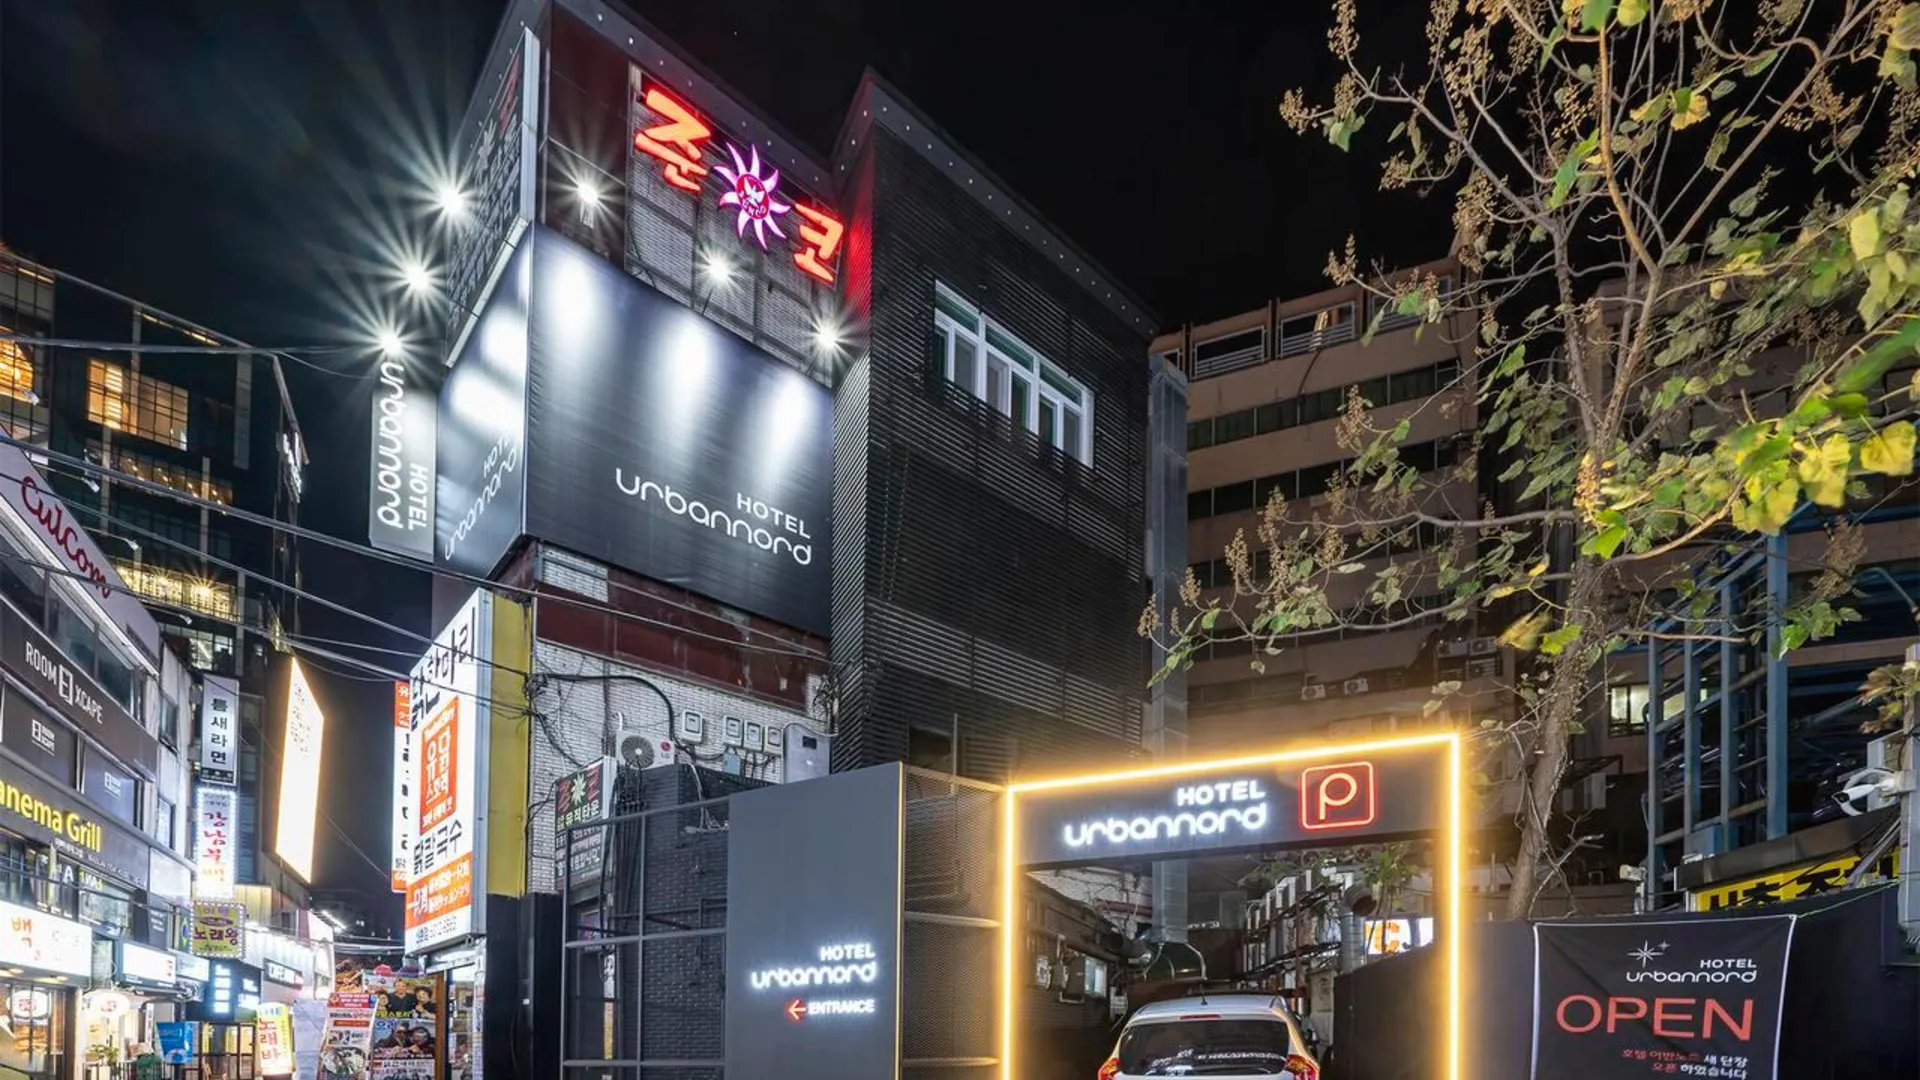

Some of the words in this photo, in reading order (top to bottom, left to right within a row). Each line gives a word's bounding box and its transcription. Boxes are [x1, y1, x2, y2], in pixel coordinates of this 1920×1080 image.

[635, 88, 711, 193] 준
[794, 202, 844, 282] 코
[377, 361, 407, 529] urbannord
[408, 462, 429, 530] HOTEL
[445, 446, 517, 560] urbannord
[616, 468, 812, 564] urbannord
[737, 492, 811, 539] HOTEL
[26, 641, 57, 685] ROOM
[1176, 780, 1266, 807] HOTEL
[66, 812, 101, 853] Grill
[1063, 803, 1267, 847] urbannord
[819, 943, 877, 961] HOTEL
[1700, 958, 1757, 968] HOTEL
[750, 961, 878, 989] urbannord
[1626, 970, 1757, 983] urbannord
[807, 999, 876, 1015] ENTRANCE
[1556, 995, 1753, 1042] OPEN
[1652, 1062, 1677, 1073] 오픈
[1680, 1063, 1748, 1080] 하였습니다
[1704, 1054, 1717, 1065] 새
[1720, 1055, 1749, 1068] 단장
